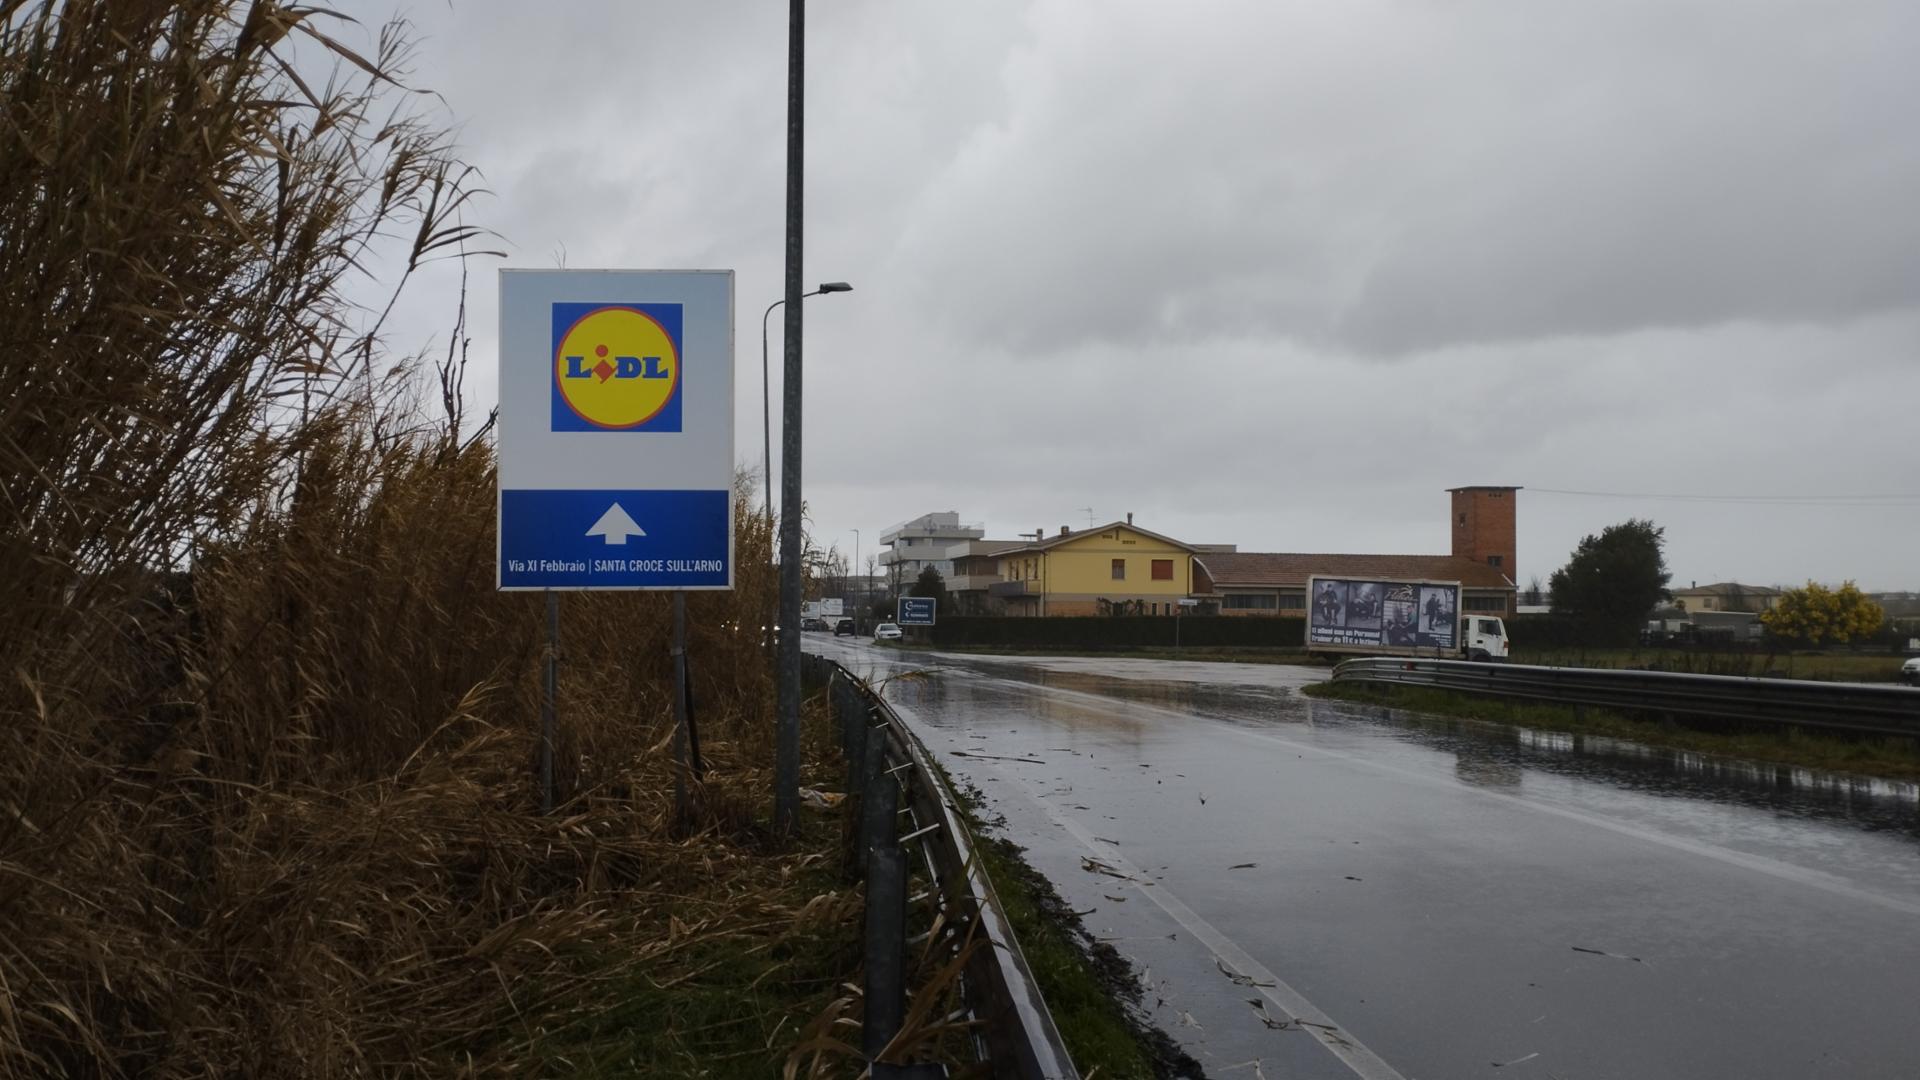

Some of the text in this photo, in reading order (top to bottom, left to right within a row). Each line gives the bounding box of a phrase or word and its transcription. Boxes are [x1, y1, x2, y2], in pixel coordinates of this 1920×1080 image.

[508, 559, 723, 572] Via XI Febbraio SANTA CROCE SULL'ARNO
